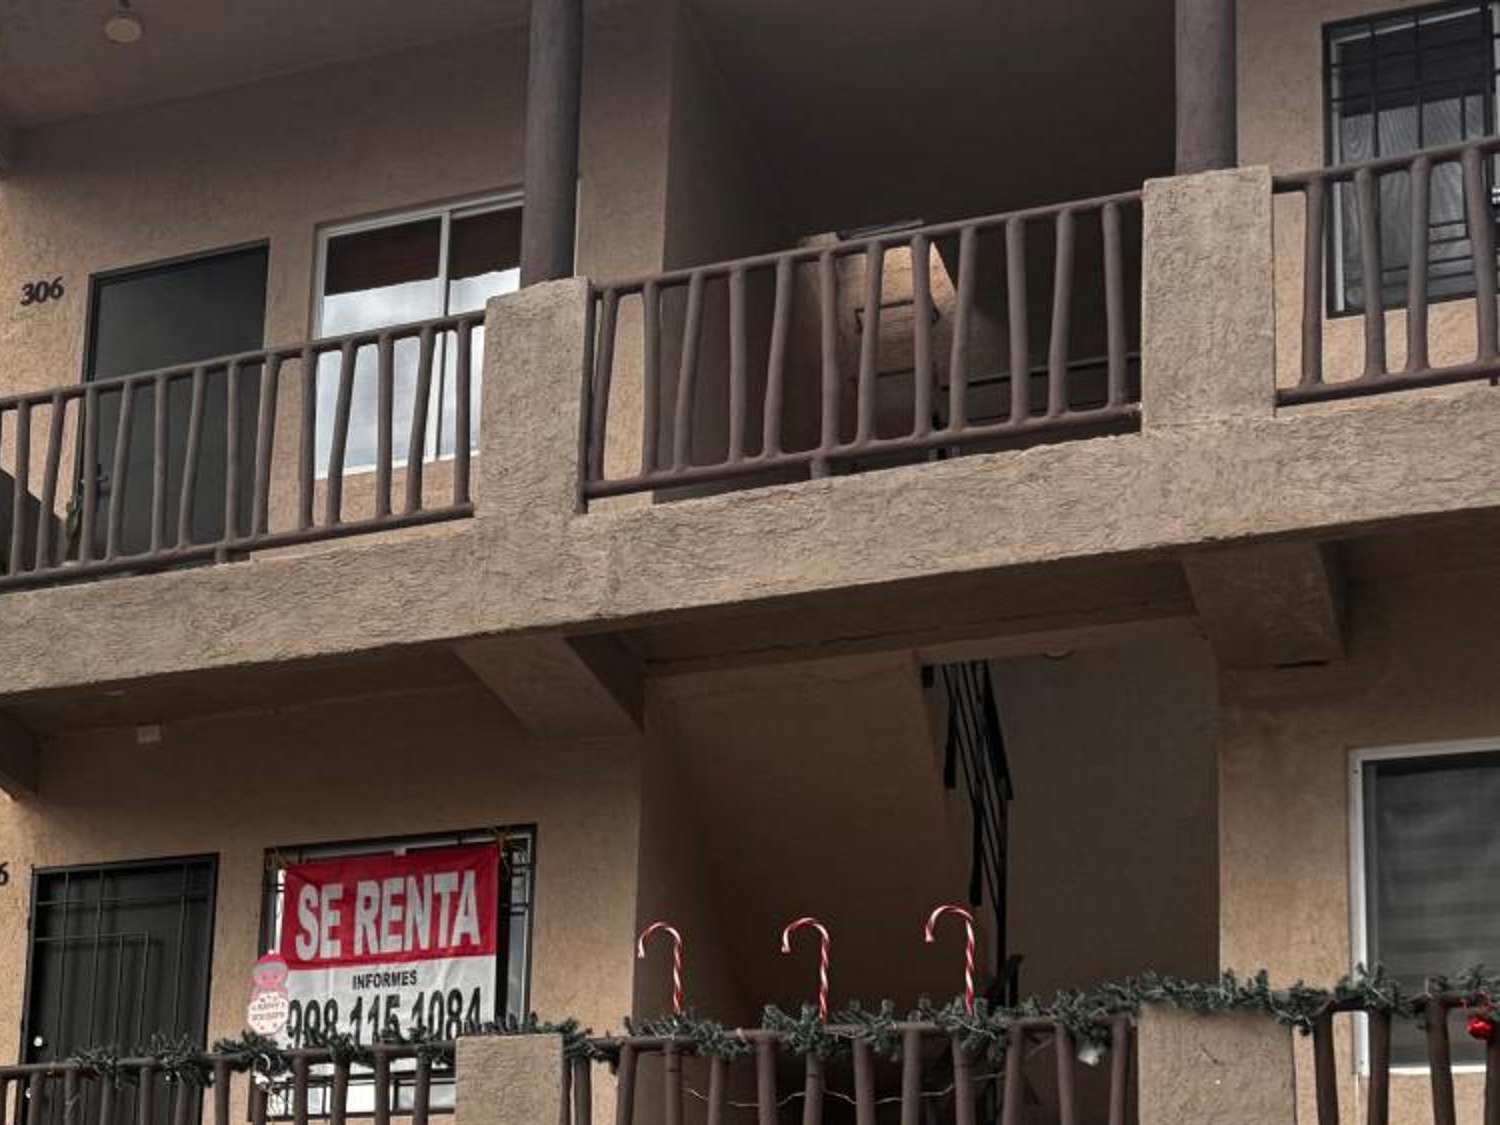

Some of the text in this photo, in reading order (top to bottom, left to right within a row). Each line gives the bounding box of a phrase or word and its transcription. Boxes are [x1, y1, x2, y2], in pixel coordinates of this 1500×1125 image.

[20, 276, 64, 306] 306
[295, 870, 481, 961] SE RENTA
[352, 969, 417, 990] INFORMES
[349, 994, 401, 1045] 115
